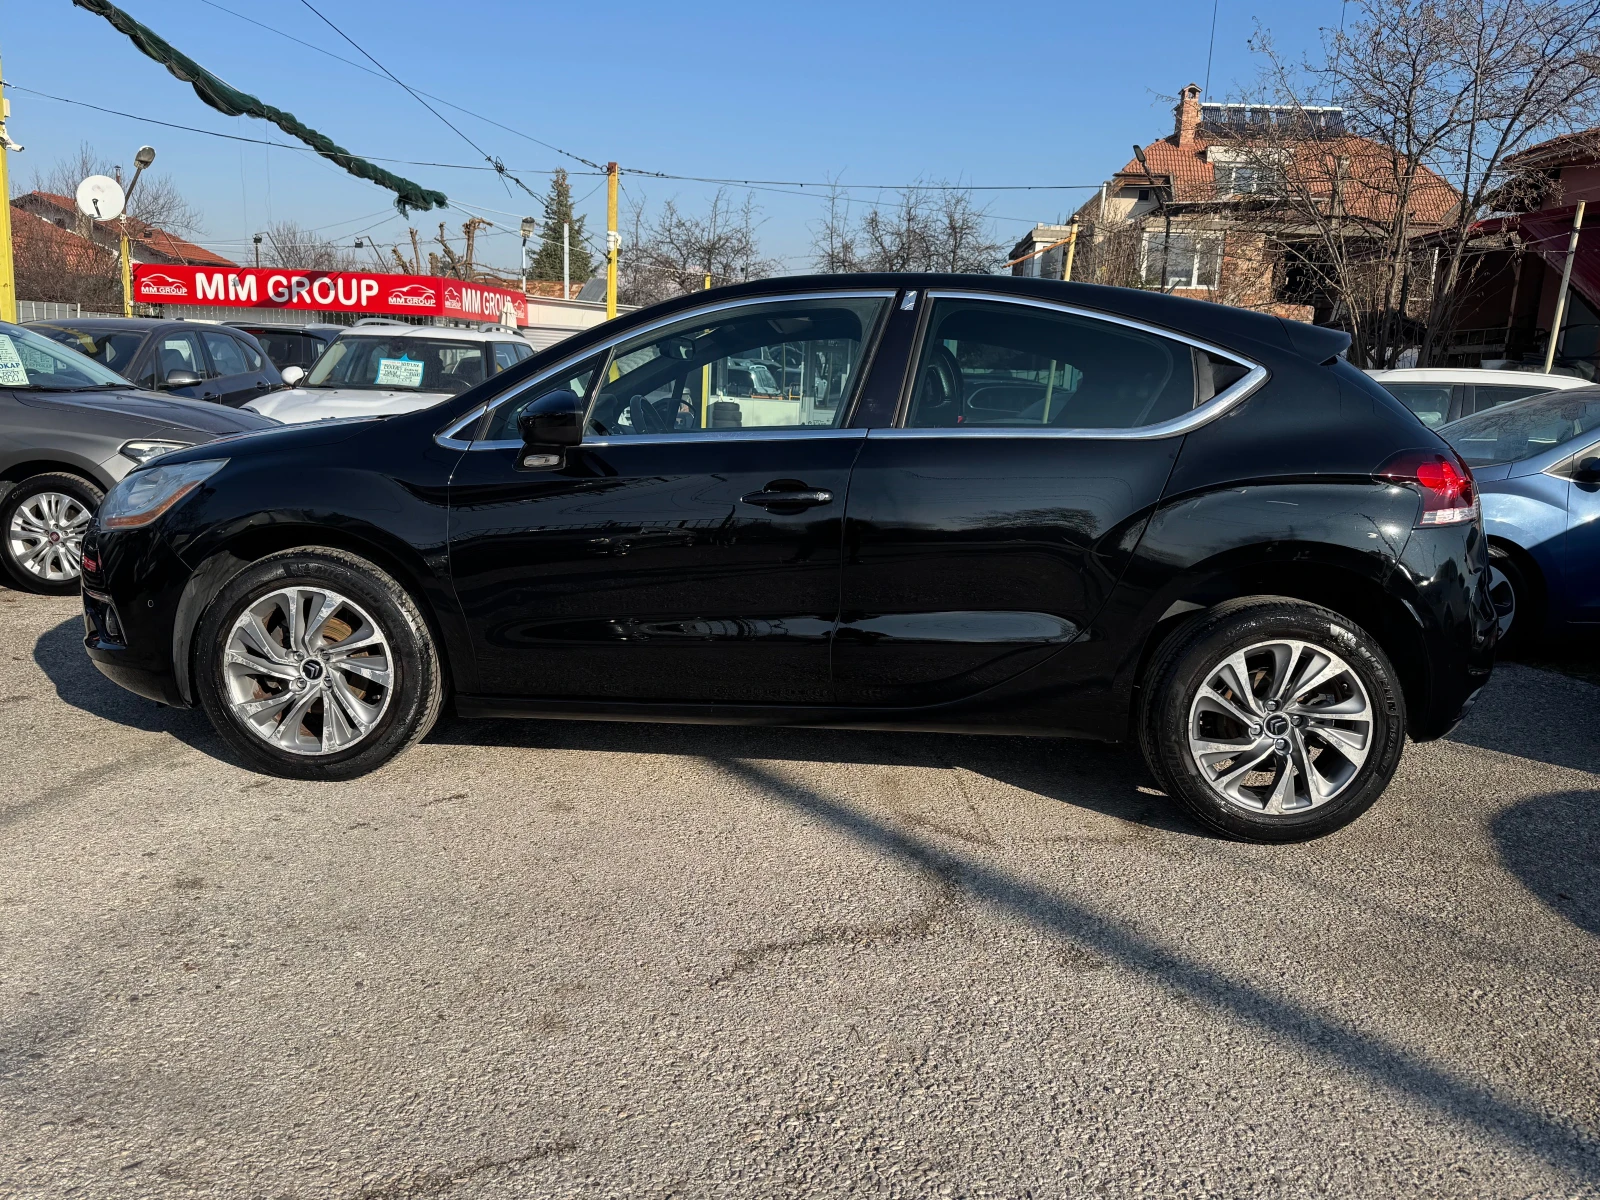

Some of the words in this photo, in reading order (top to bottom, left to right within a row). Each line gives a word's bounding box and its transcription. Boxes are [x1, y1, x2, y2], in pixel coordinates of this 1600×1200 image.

[195, 272, 258, 302] MM
[267, 275, 379, 307] GROUP
[406, 298, 436, 306] GROUP
[462, 287, 481, 314] MM
